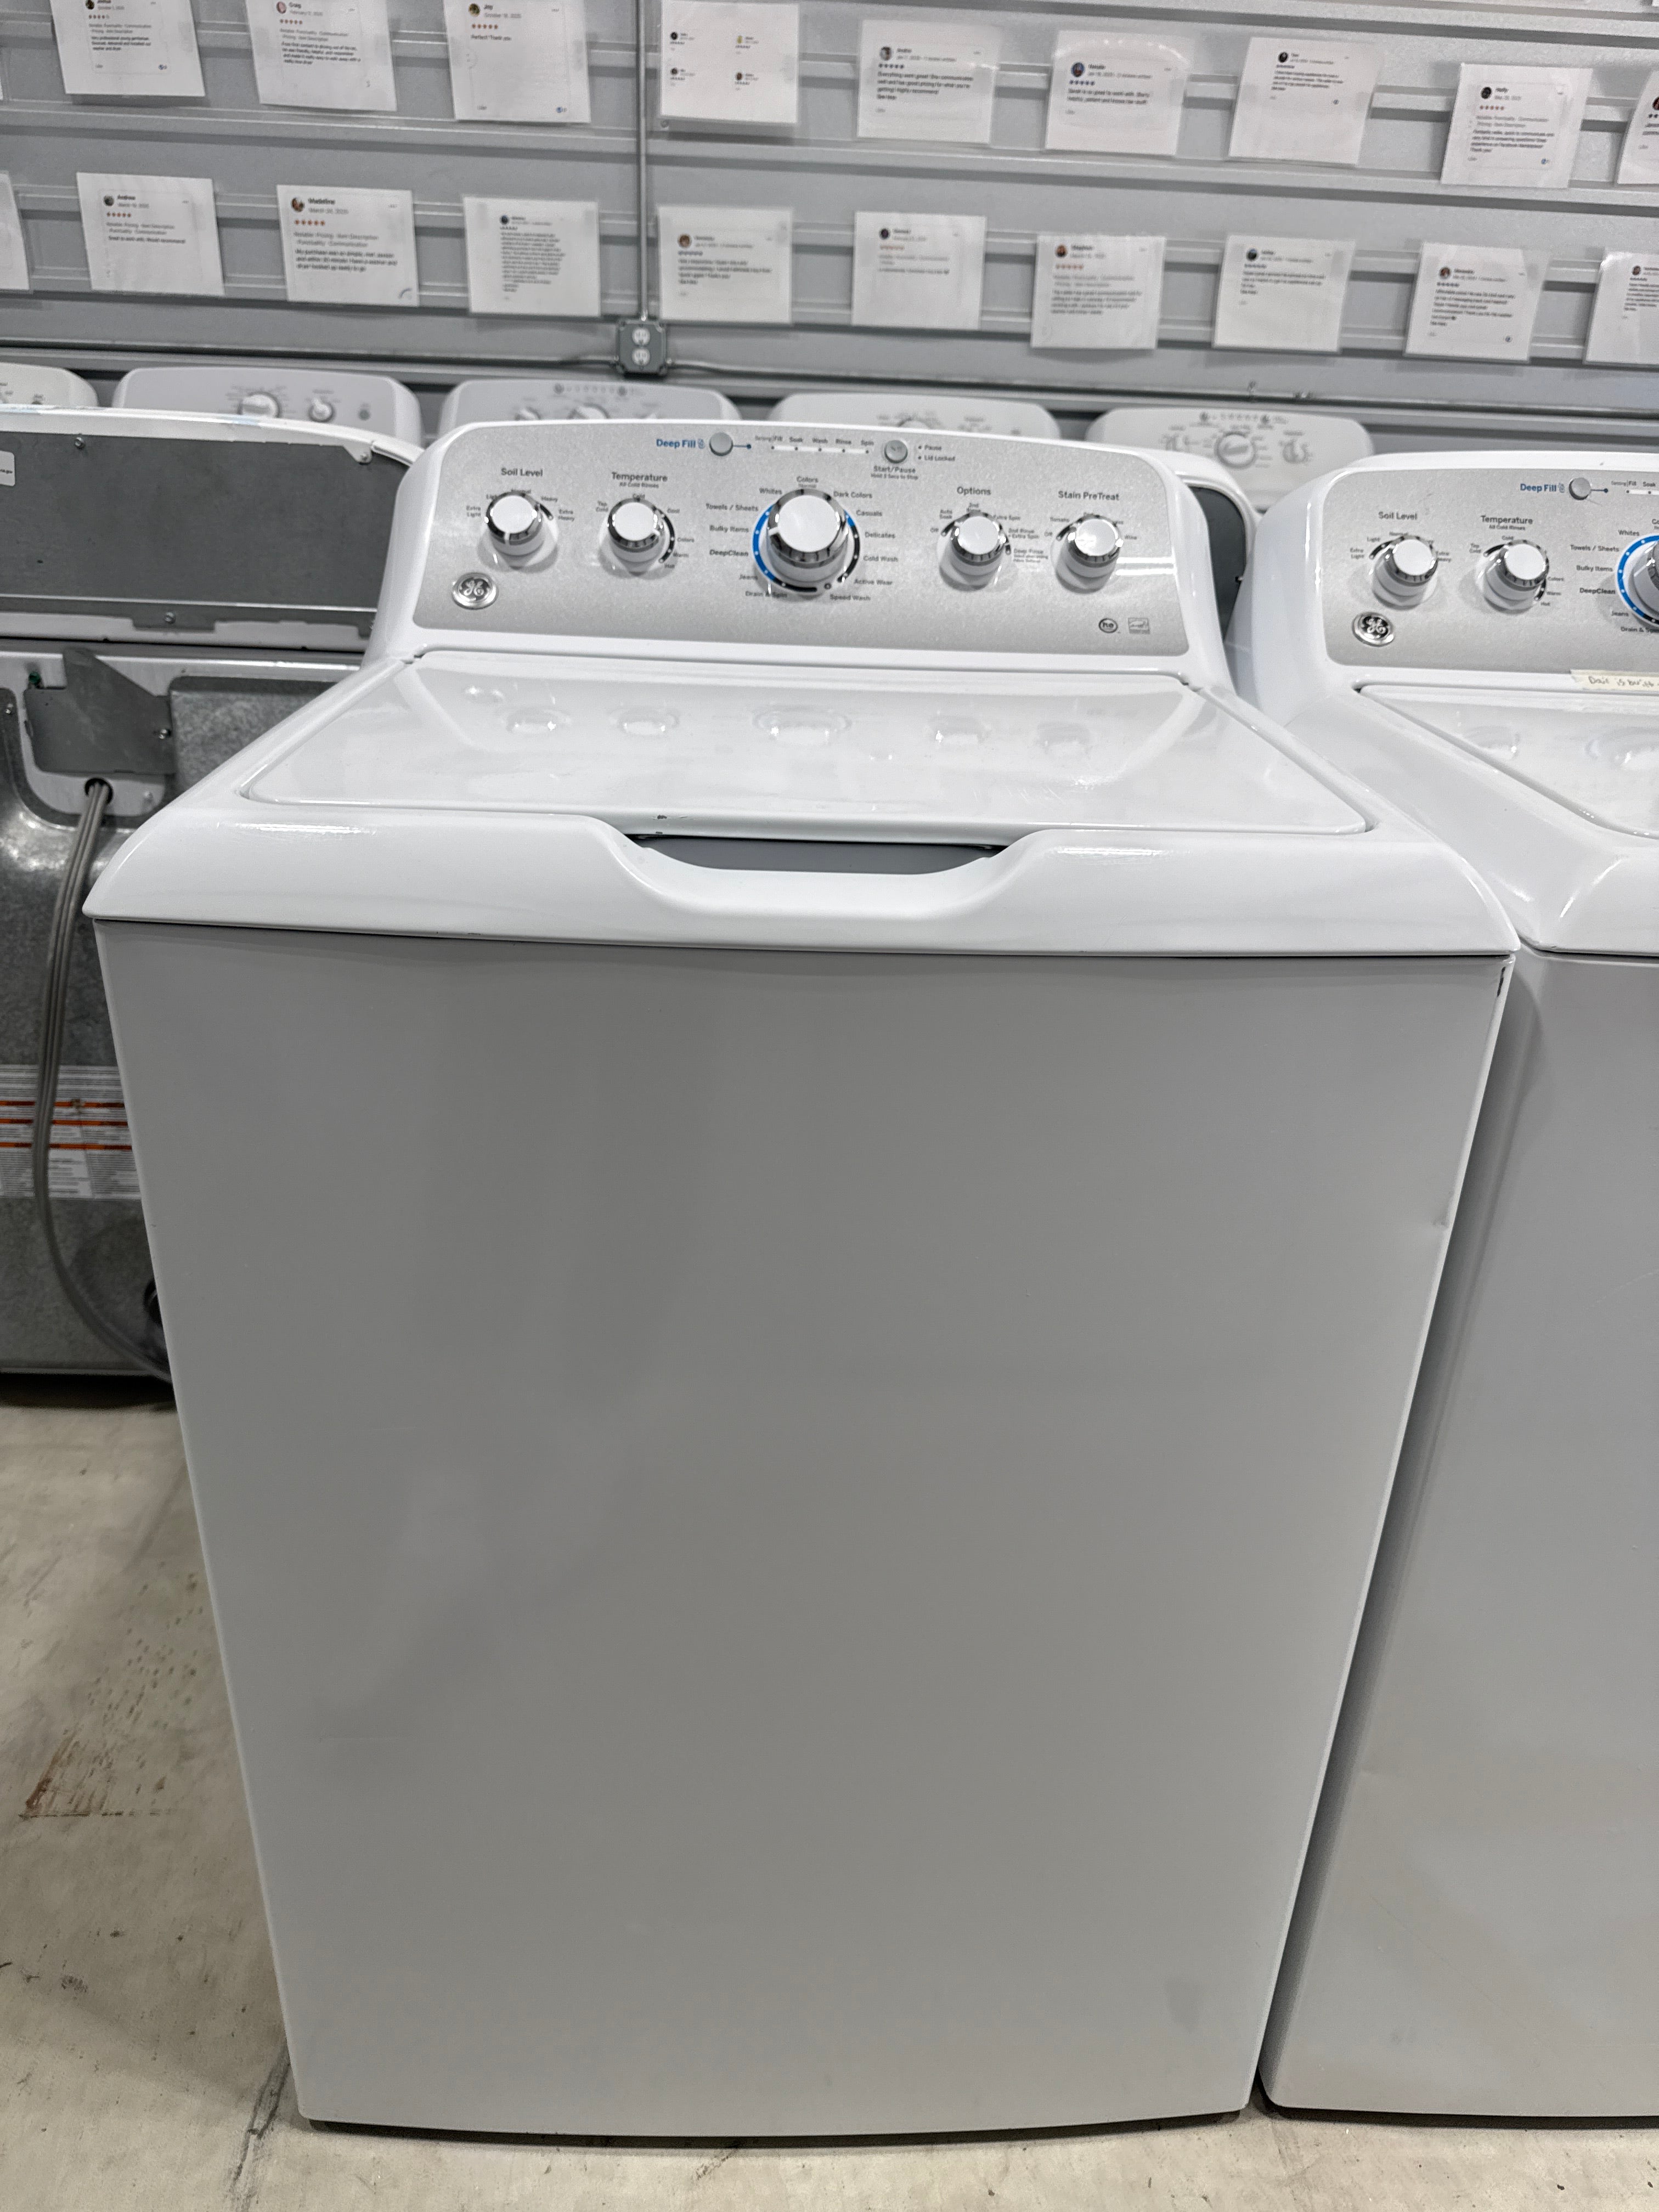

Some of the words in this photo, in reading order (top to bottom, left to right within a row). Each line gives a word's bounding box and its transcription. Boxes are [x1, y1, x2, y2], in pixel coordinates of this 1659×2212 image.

[656, 439, 680, 448] Deep
[501, 468, 518, 476] Soil
[520, 469, 543, 477] Level
[873, 465, 916, 474] Start/Pause
[612, 472, 668, 482] Temperature
[957, 486, 991, 495] Options
[1520, 483, 1542, 493] Deep
[1058, 490, 1081, 499] Stain
[1083, 492, 1120, 501] PreTreat
[1379, 511, 1394, 520] Soil
[1481, 515, 1533, 525] Temperature
[709, 525, 728, 533] Bulky
